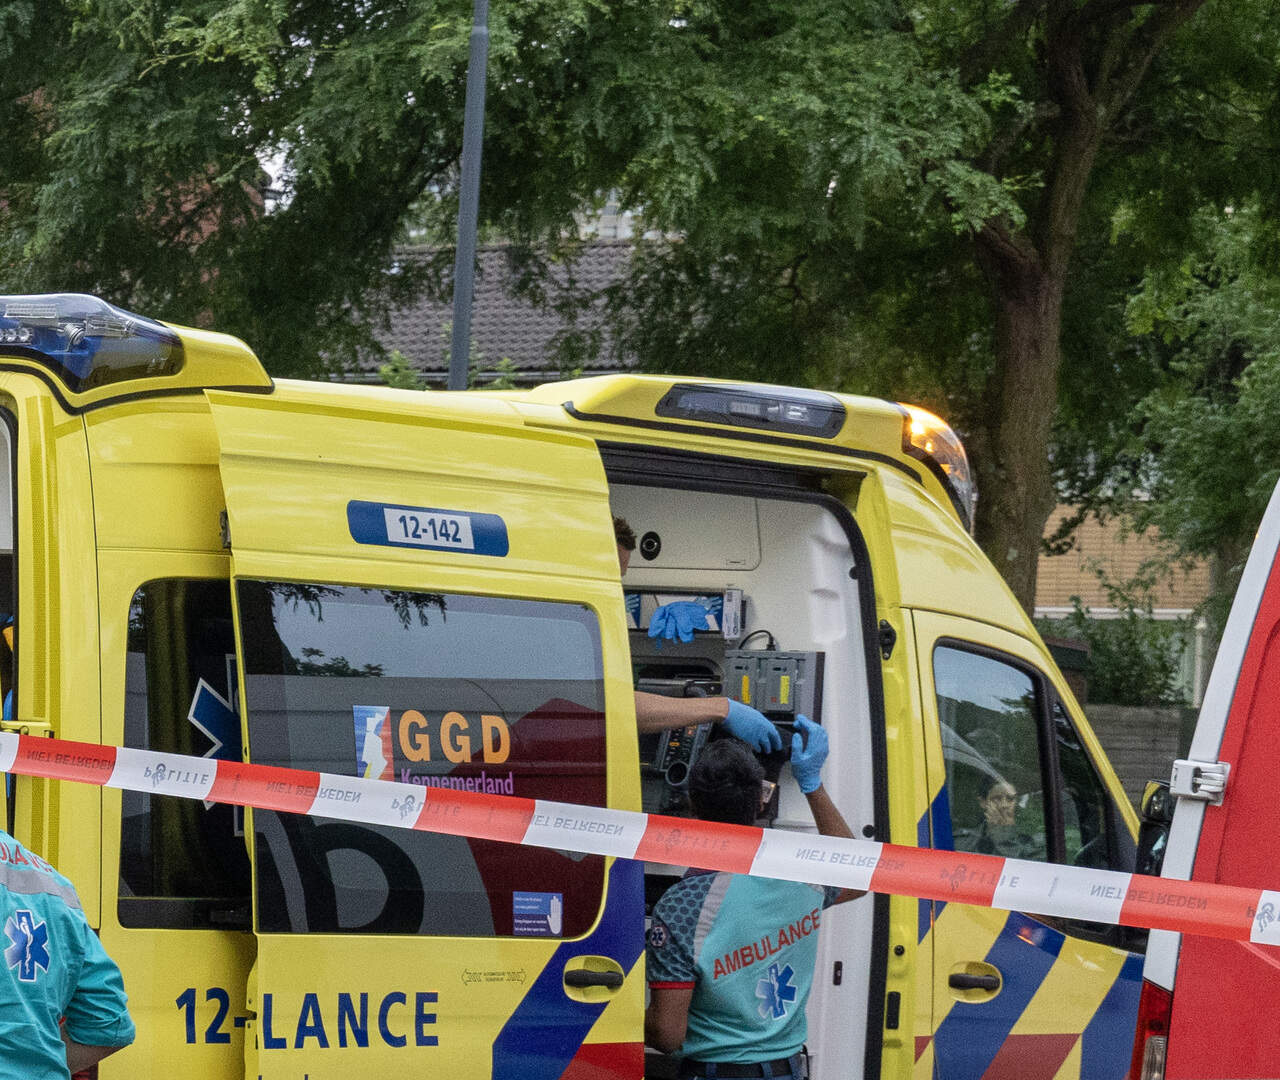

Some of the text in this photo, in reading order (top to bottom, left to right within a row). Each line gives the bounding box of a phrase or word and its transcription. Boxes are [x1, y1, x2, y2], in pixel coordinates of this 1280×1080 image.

[399, 515, 462, 543] 12-142
[399, 709, 511, 764] GGD
[401, 768, 514, 794] Kennemerland
[714, 908, 820, 980] AMBULANCE
[262, 991, 439, 1049] LANCE
